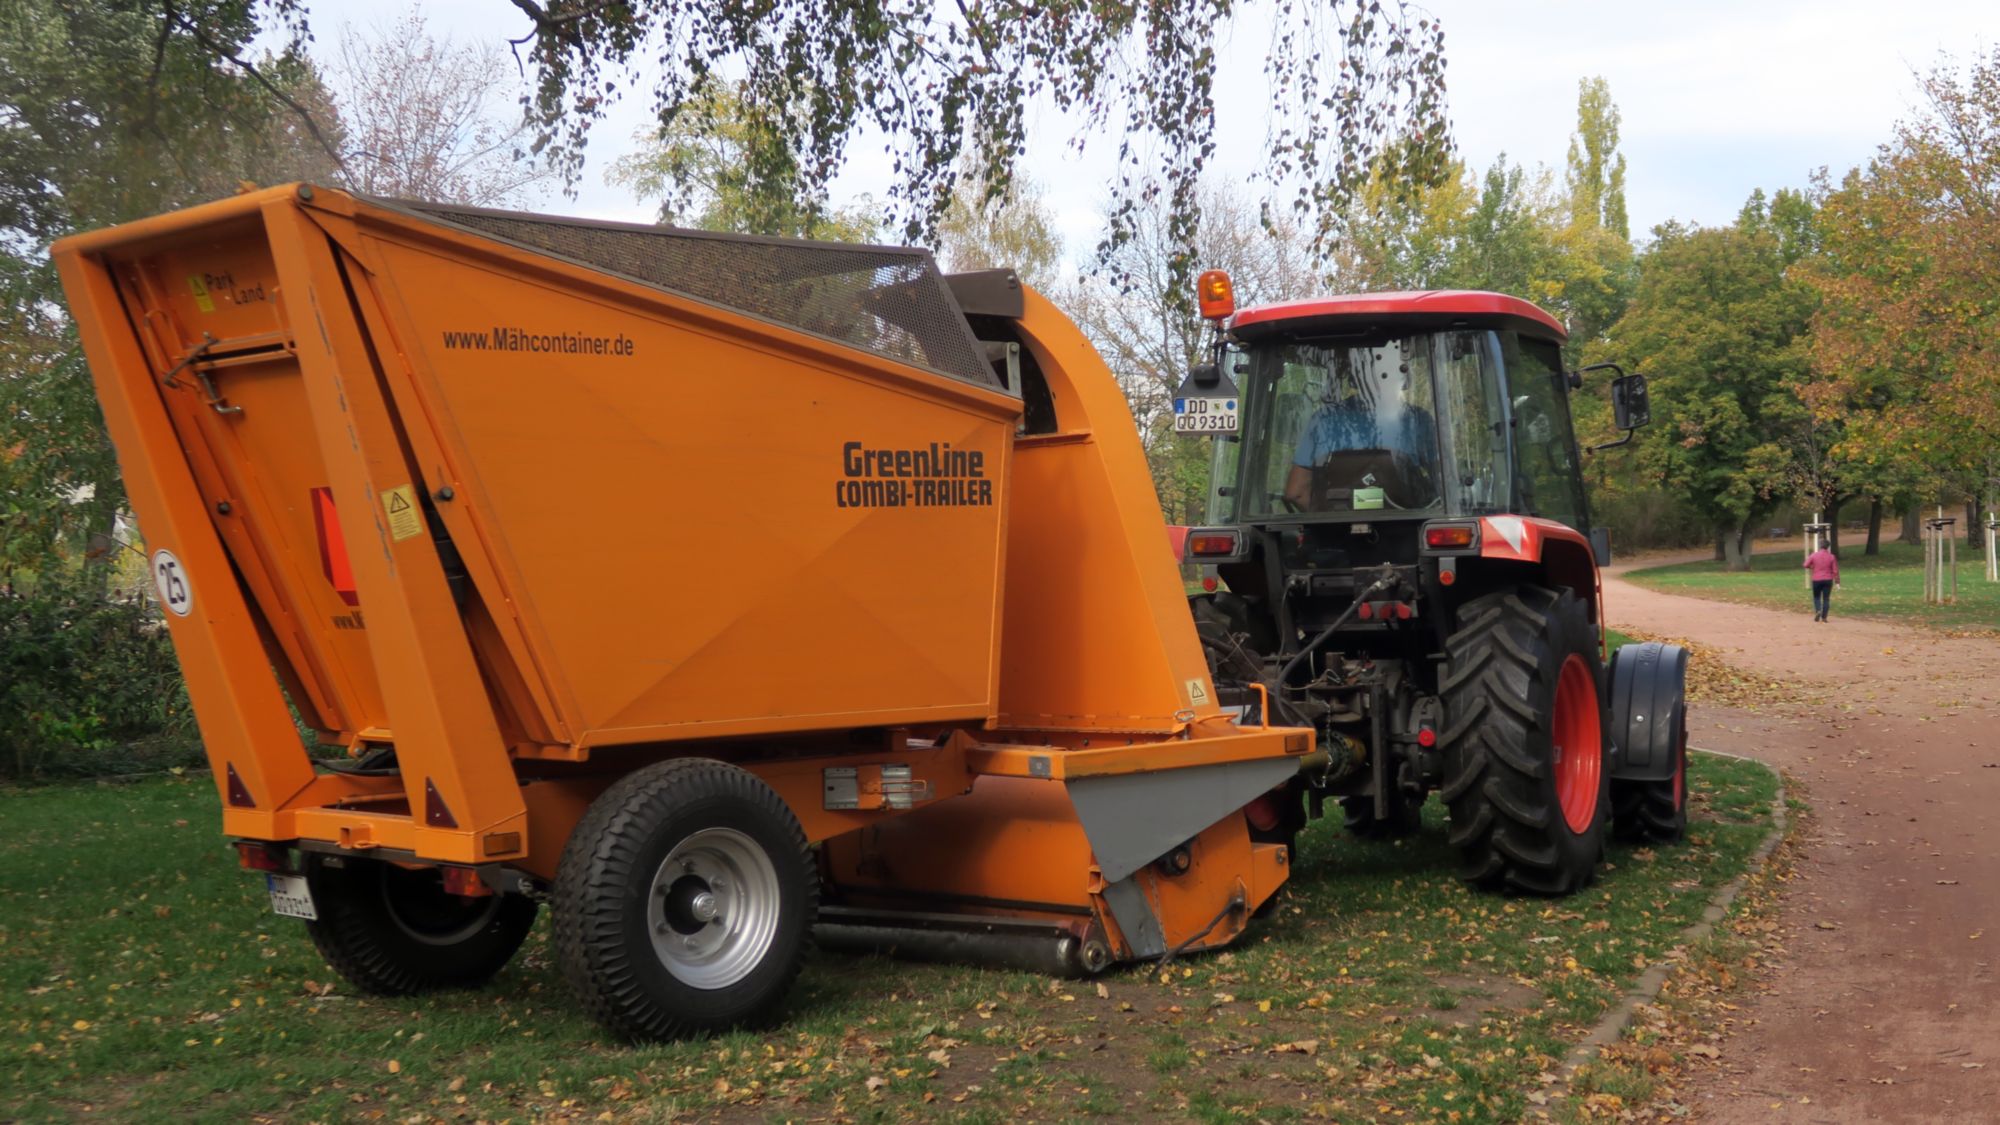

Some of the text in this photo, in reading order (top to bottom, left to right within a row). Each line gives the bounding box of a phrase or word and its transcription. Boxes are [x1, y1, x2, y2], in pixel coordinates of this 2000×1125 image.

[204, 269, 236, 291] Park
[230, 281, 266, 305] Land
[442, 327, 634, 356] www.Mähcontainer.de
[1189, 400, 1208, 414] DD
[1199, 415, 1236, 429] 9310
[843, 441, 984, 478] GreenLine
[836, 479, 993, 508] COMBI-TRAILER
[159, 561, 187, 605] 25
